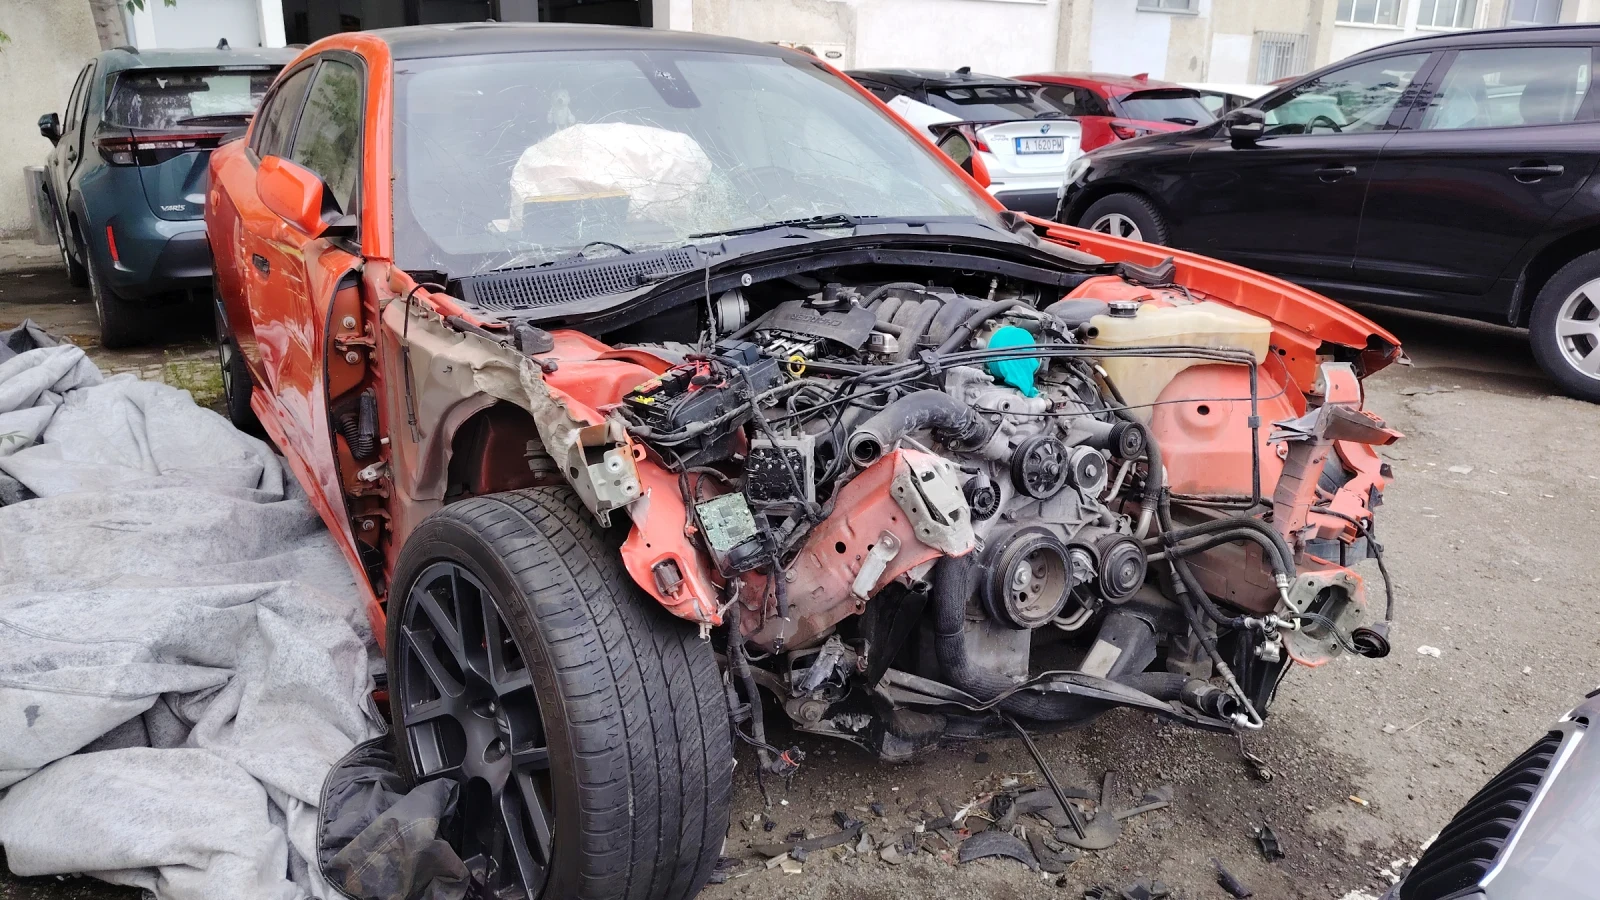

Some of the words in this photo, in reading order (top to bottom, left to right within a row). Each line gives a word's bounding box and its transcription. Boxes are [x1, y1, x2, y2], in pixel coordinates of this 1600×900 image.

[1034, 140, 1051, 151] 1620
[160, 204, 186, 212] YARIS
[790, 313, 843, 327] CHARGER
